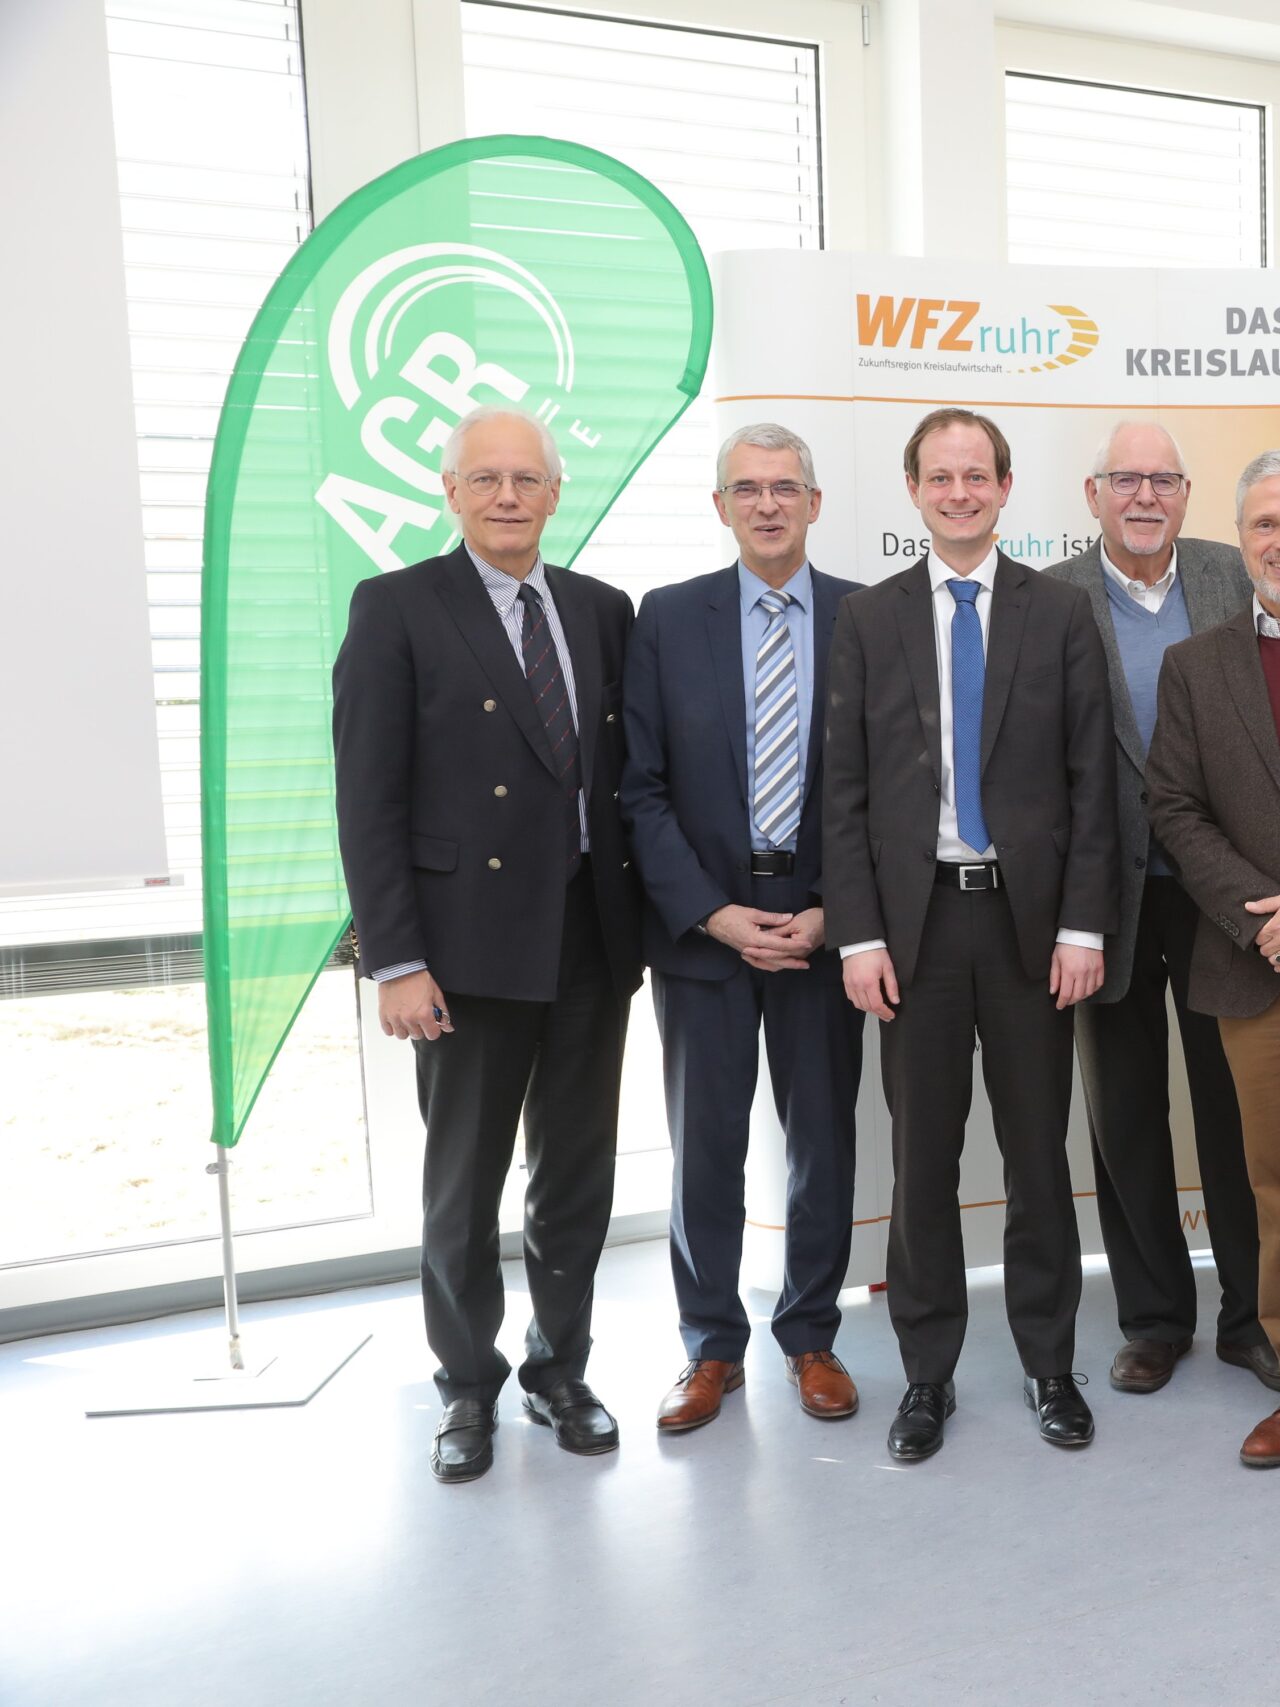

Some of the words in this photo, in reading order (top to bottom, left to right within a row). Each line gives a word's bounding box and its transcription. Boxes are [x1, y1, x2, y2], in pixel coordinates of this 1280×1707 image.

[858, 357, 922, 371] Zukunftsregion
[923, 361, 1003, 374] Kreislaufwirtschaft
[314, 331, 531, 574] AGR
[882, 532, 931, 557] Das
